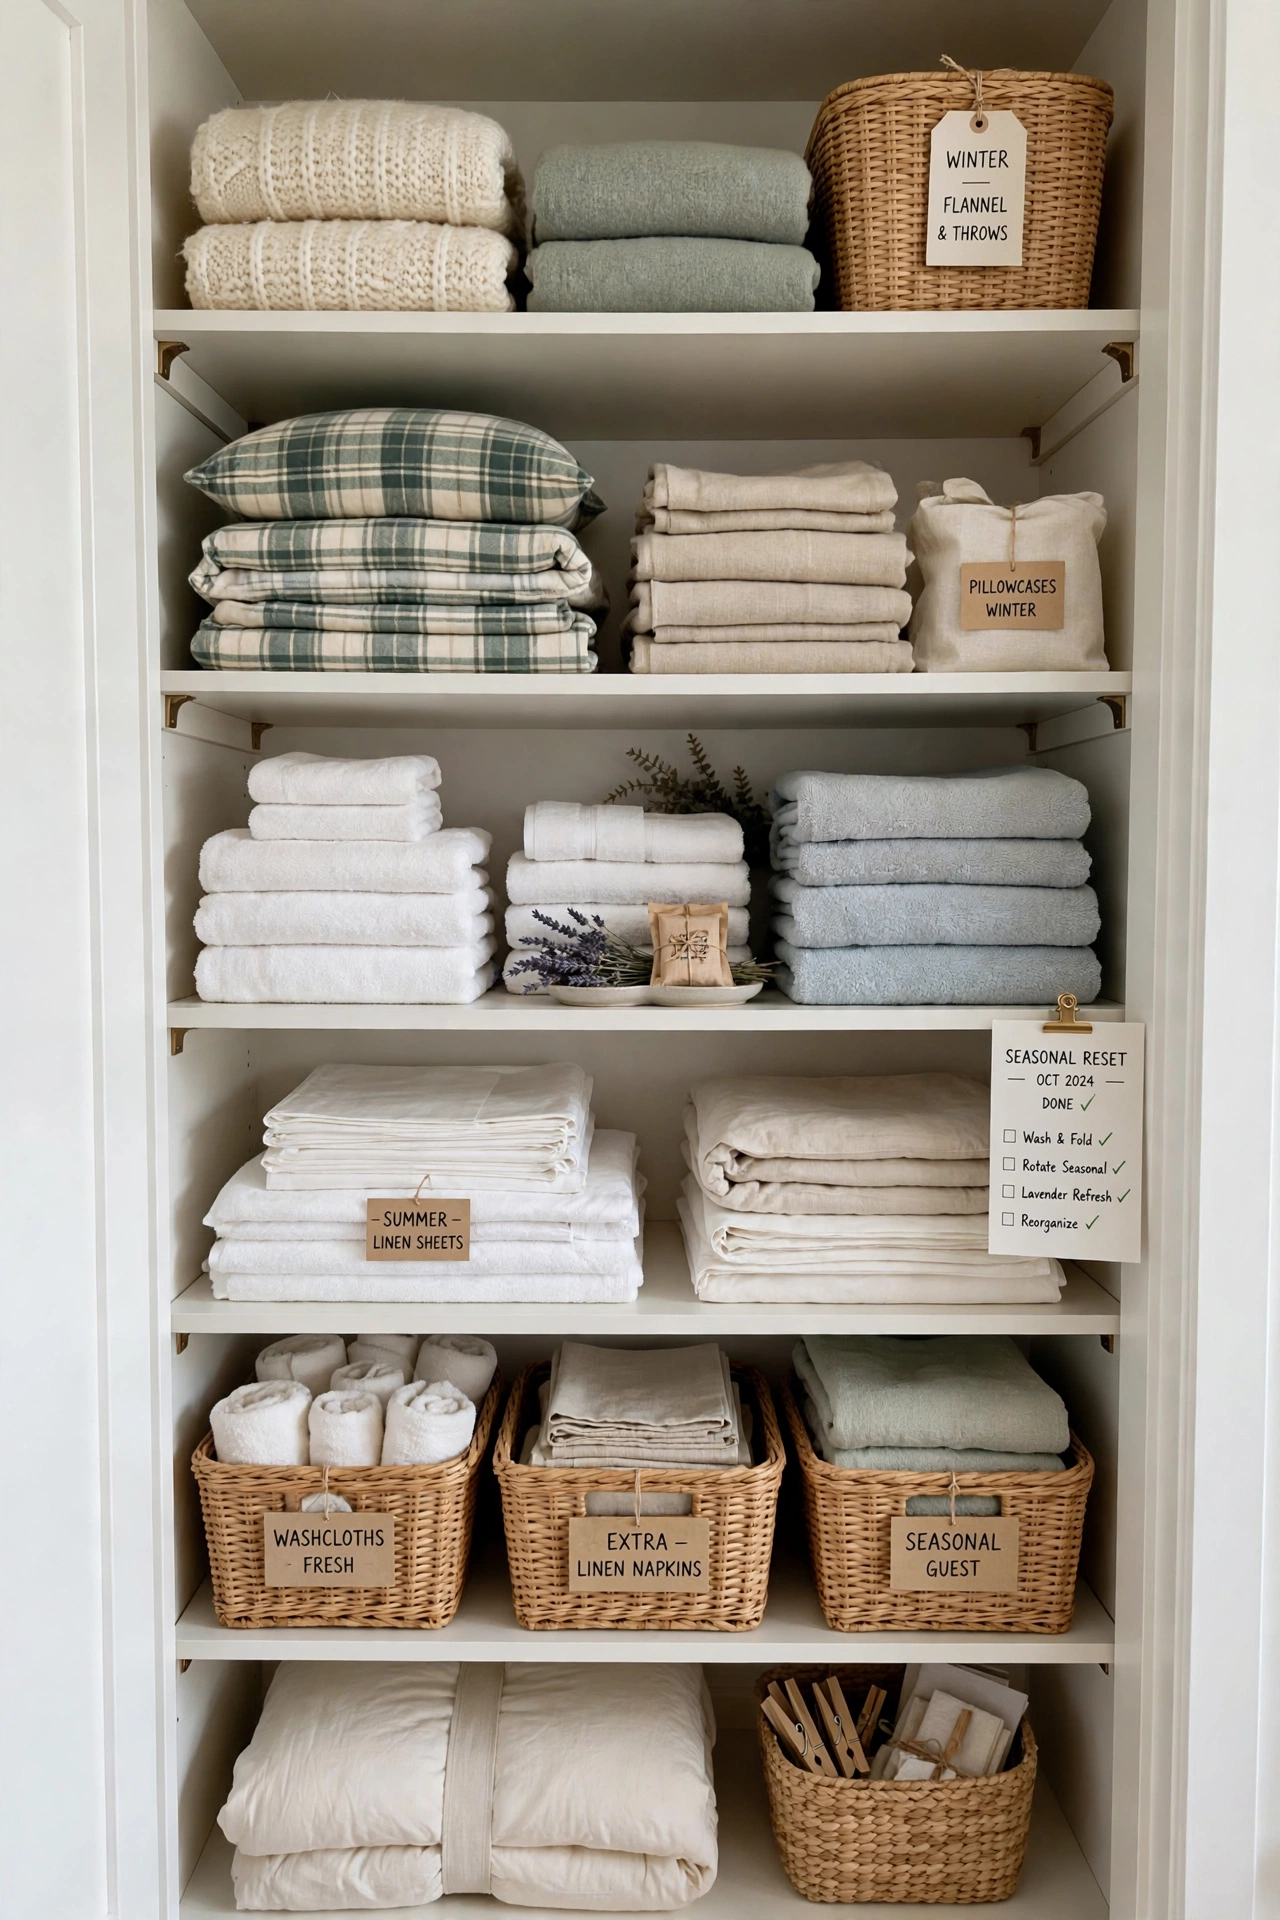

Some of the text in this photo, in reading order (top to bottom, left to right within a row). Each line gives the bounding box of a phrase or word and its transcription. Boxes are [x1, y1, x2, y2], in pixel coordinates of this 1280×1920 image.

[946, 149, 1009, 169] WINTER
[943, 196, 1008, 214] FLANNEL
[937, 224, 1008, 241] & THROWS
[969, 578, 1057, 595] PILLOWCASES
[985, 602, 1037, 618] WINTER
[1005, 1048, 1128, 1067] SEASONAL RESET
[1036, 1073, 1095, 1088] OCT 2024
[1042, 1096, 1074, 1110] DONE
[1022, 1130, 1093, 1146] Wash & Fold
[1022, 1158, 1108, 1175] Rotate Seasonal
[1021, 1186, 1112, 1203] Lavender Refresh
[383, 1210, 448, 1228] SUMMER
[1021, 1213, 1079, 1234] Reorganize
[373, 1234, 464, 1250] LINEN SHEETS
[273, 1528, 385, 1548] WASHCLOTHS
[607, 1532, 668, 1551] EXTRA
[905, 1531, 1002, 1552] SEASONAL
[303, 1556, 354, 1574] FRESH
[577, 1559, 702, 1578] LINEN NAPKINS
[926, 1559, 981, 1578] GUEST
